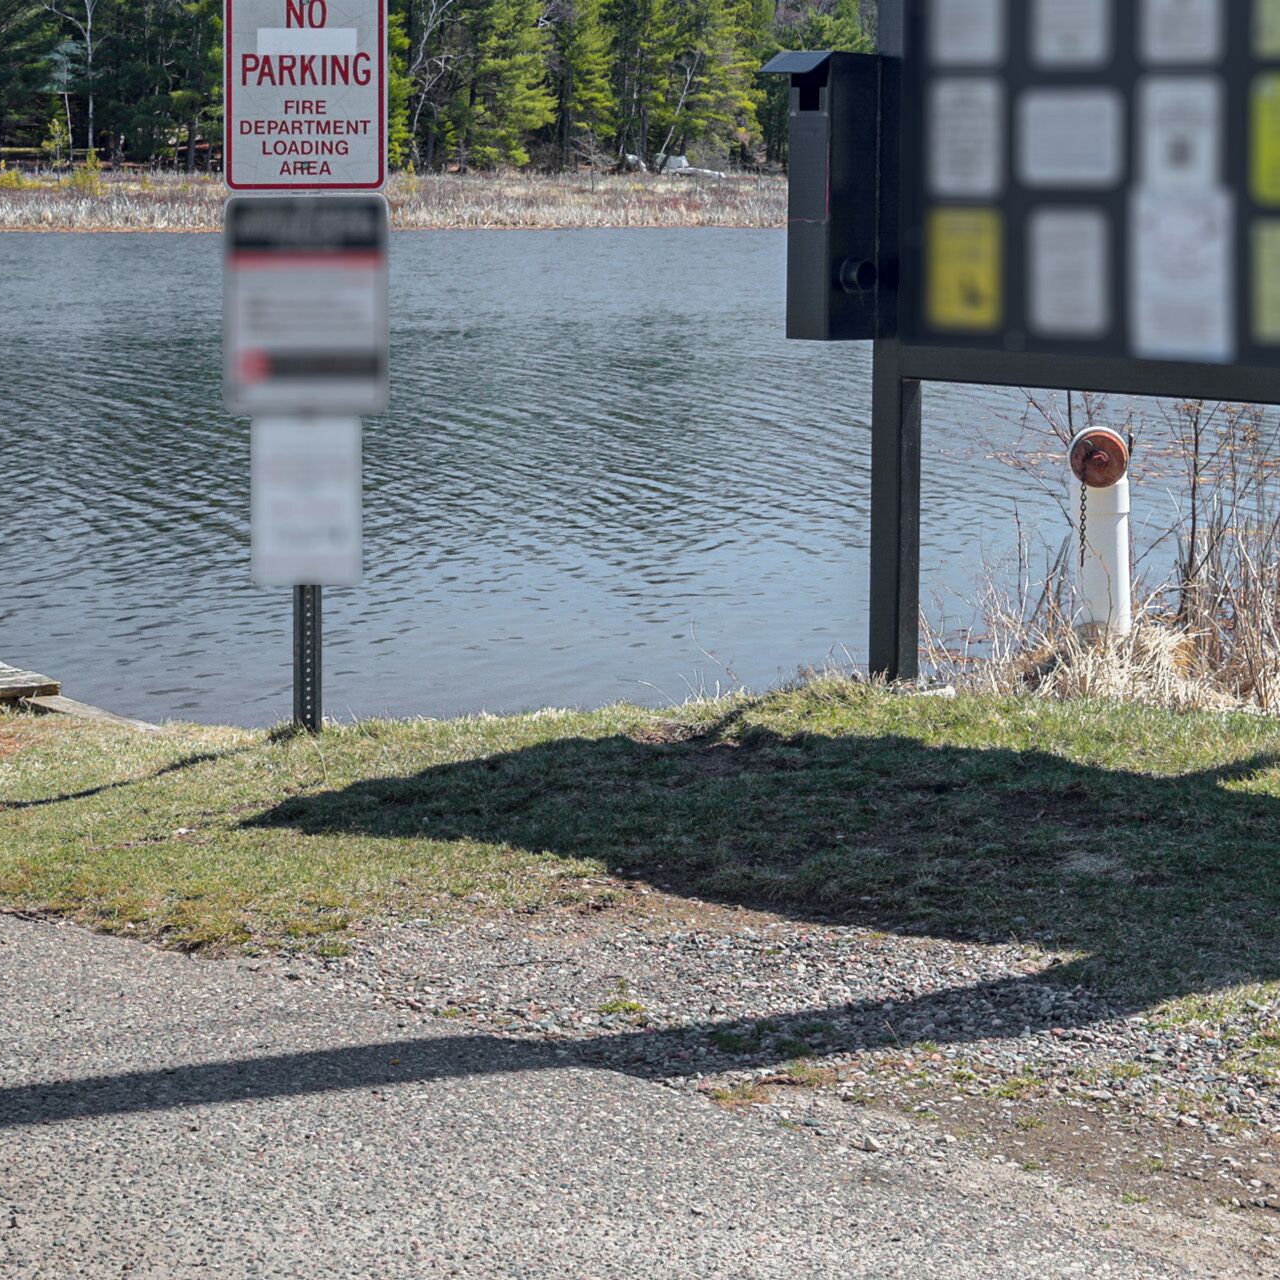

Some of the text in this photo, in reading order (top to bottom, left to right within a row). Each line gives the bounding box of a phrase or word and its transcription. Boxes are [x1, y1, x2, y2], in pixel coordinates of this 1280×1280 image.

[241, 52, 372, 86] PARKING
[284, 100, 327, 115] FIRE
[239, 120, 371, 135] DEPARTMENT
[262, 140, 349, 156] LOADING
[279, 161, 332, 176] AREA
